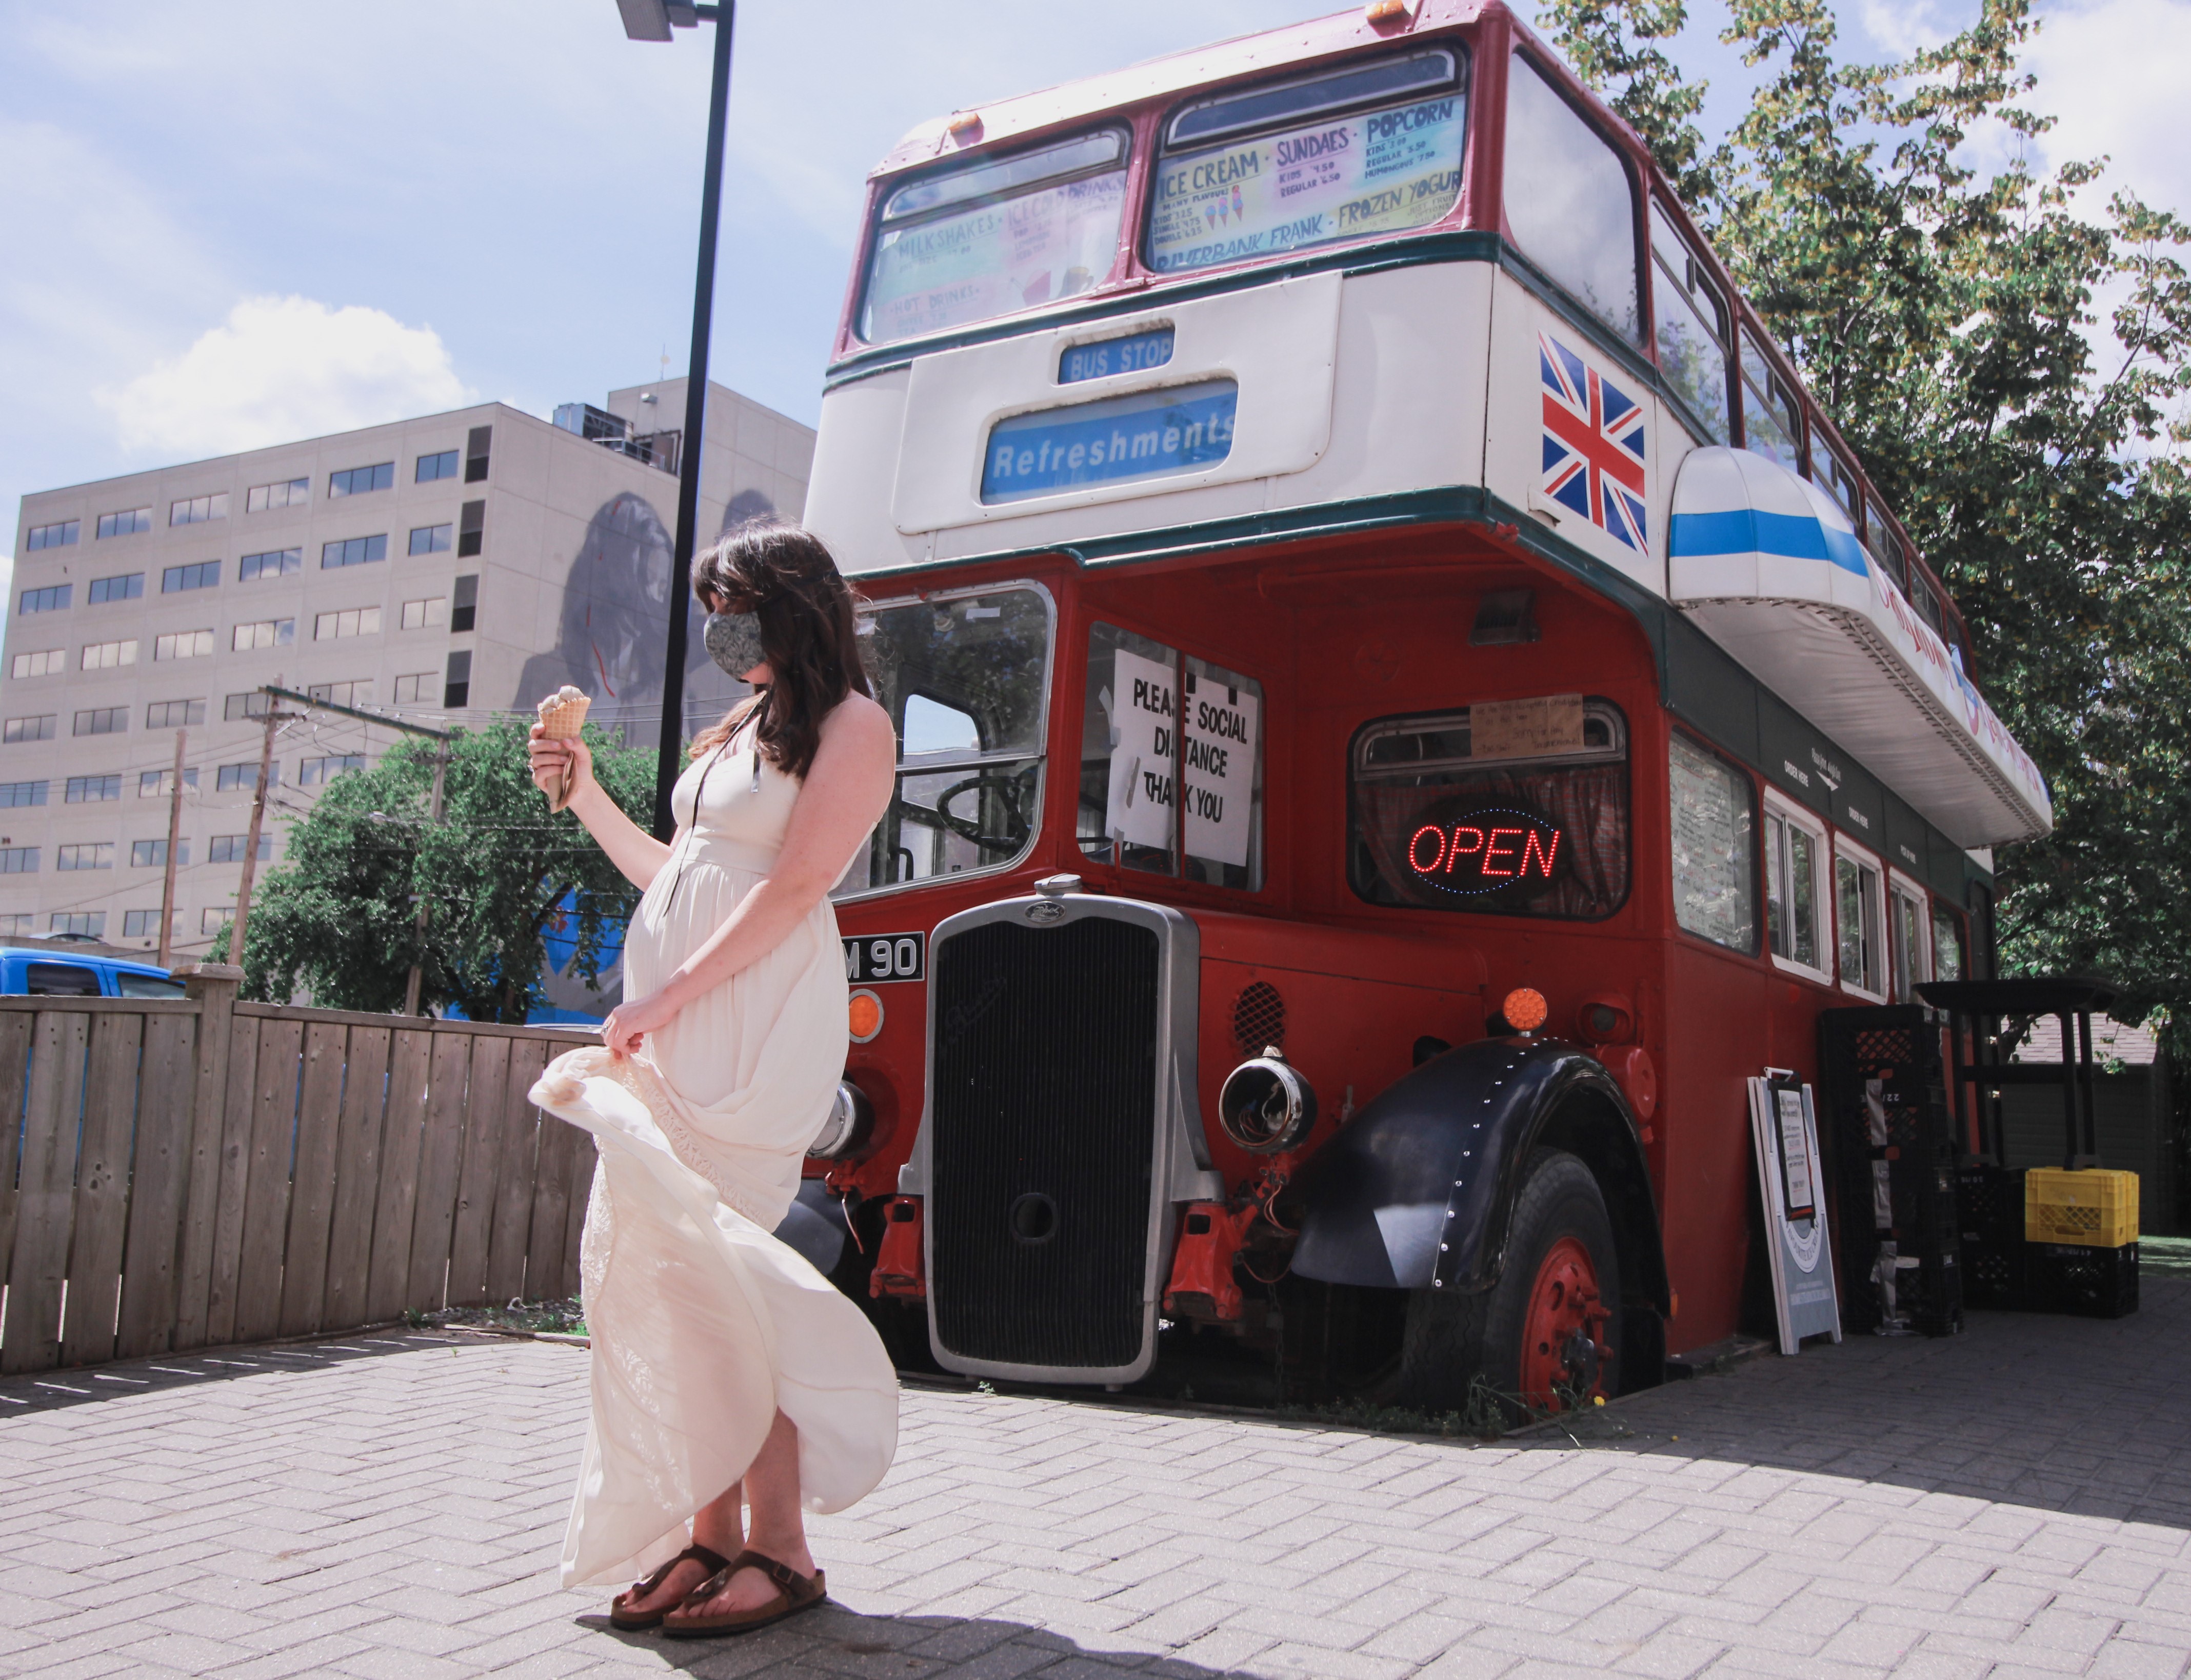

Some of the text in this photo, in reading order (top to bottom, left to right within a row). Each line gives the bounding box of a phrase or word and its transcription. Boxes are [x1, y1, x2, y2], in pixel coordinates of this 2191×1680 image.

[1367, 101, 1453, 143] POPCORN
[1277, 127, 1349, 167] SUNDAES
[1366, 150, 1402, 169] REGULAR
[1067, 176, 1125, 200] DRINKS
[1159, 150, 1259, 201] ICE CREAM
[1192, 188, 1229, 203] FLAVOURS
[1279, 170, 1302, 184] KIDS
[1281, 179, 1317, 198] REGULAR
[1338, 187, 1403, 229] FROZEN
[1270, 213, 1323, 247] FRANK
[894, 285, 973, 315] HOT DRINKS
[1071, 337, 1173, 382] BUS STOP
[992, 412, 1234, 478] Refreshments
[1134, 678, 1247, 744] PLEAE SOCIAL
[1154, 726, 1228, 778] DITANCE
[1784, 759, 1809, 788] ORDER HERE
[1144, 771, 1223, 823] THAK YOU
[1408, 825, 1561, 877] OPEN
[870, 938, 917, 977] 90
